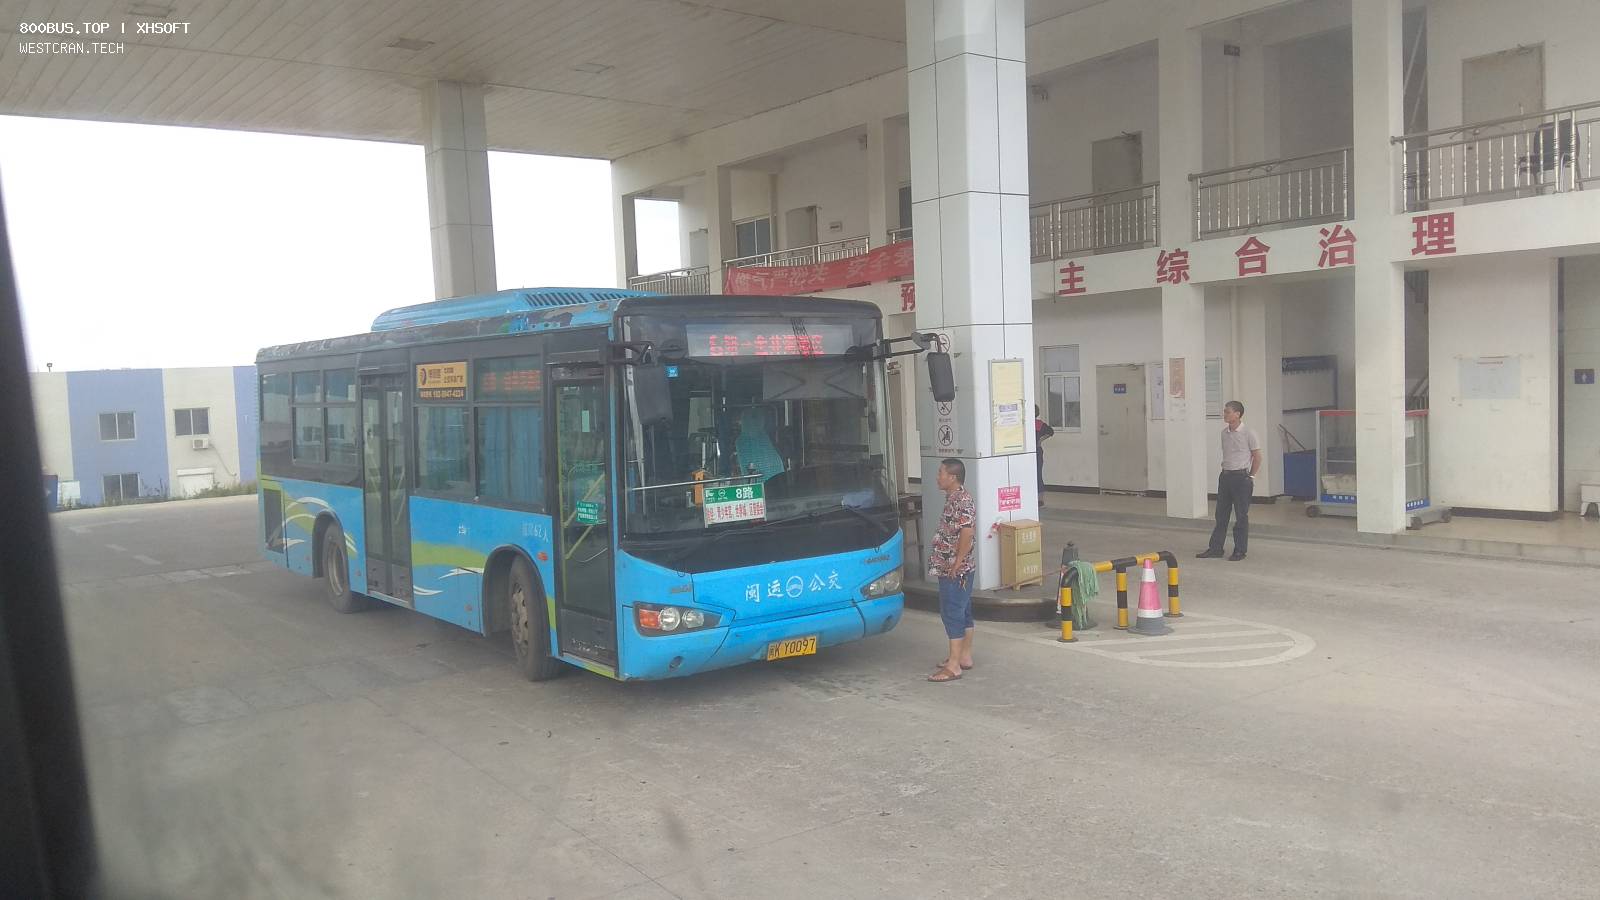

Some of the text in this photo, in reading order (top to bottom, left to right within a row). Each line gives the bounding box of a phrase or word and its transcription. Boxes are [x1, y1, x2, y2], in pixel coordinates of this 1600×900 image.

[735, 486, 754, 500] 8路
[745, 568, 843, 603] 闽运 公交
[784, 637, 816, 656] Y0097
